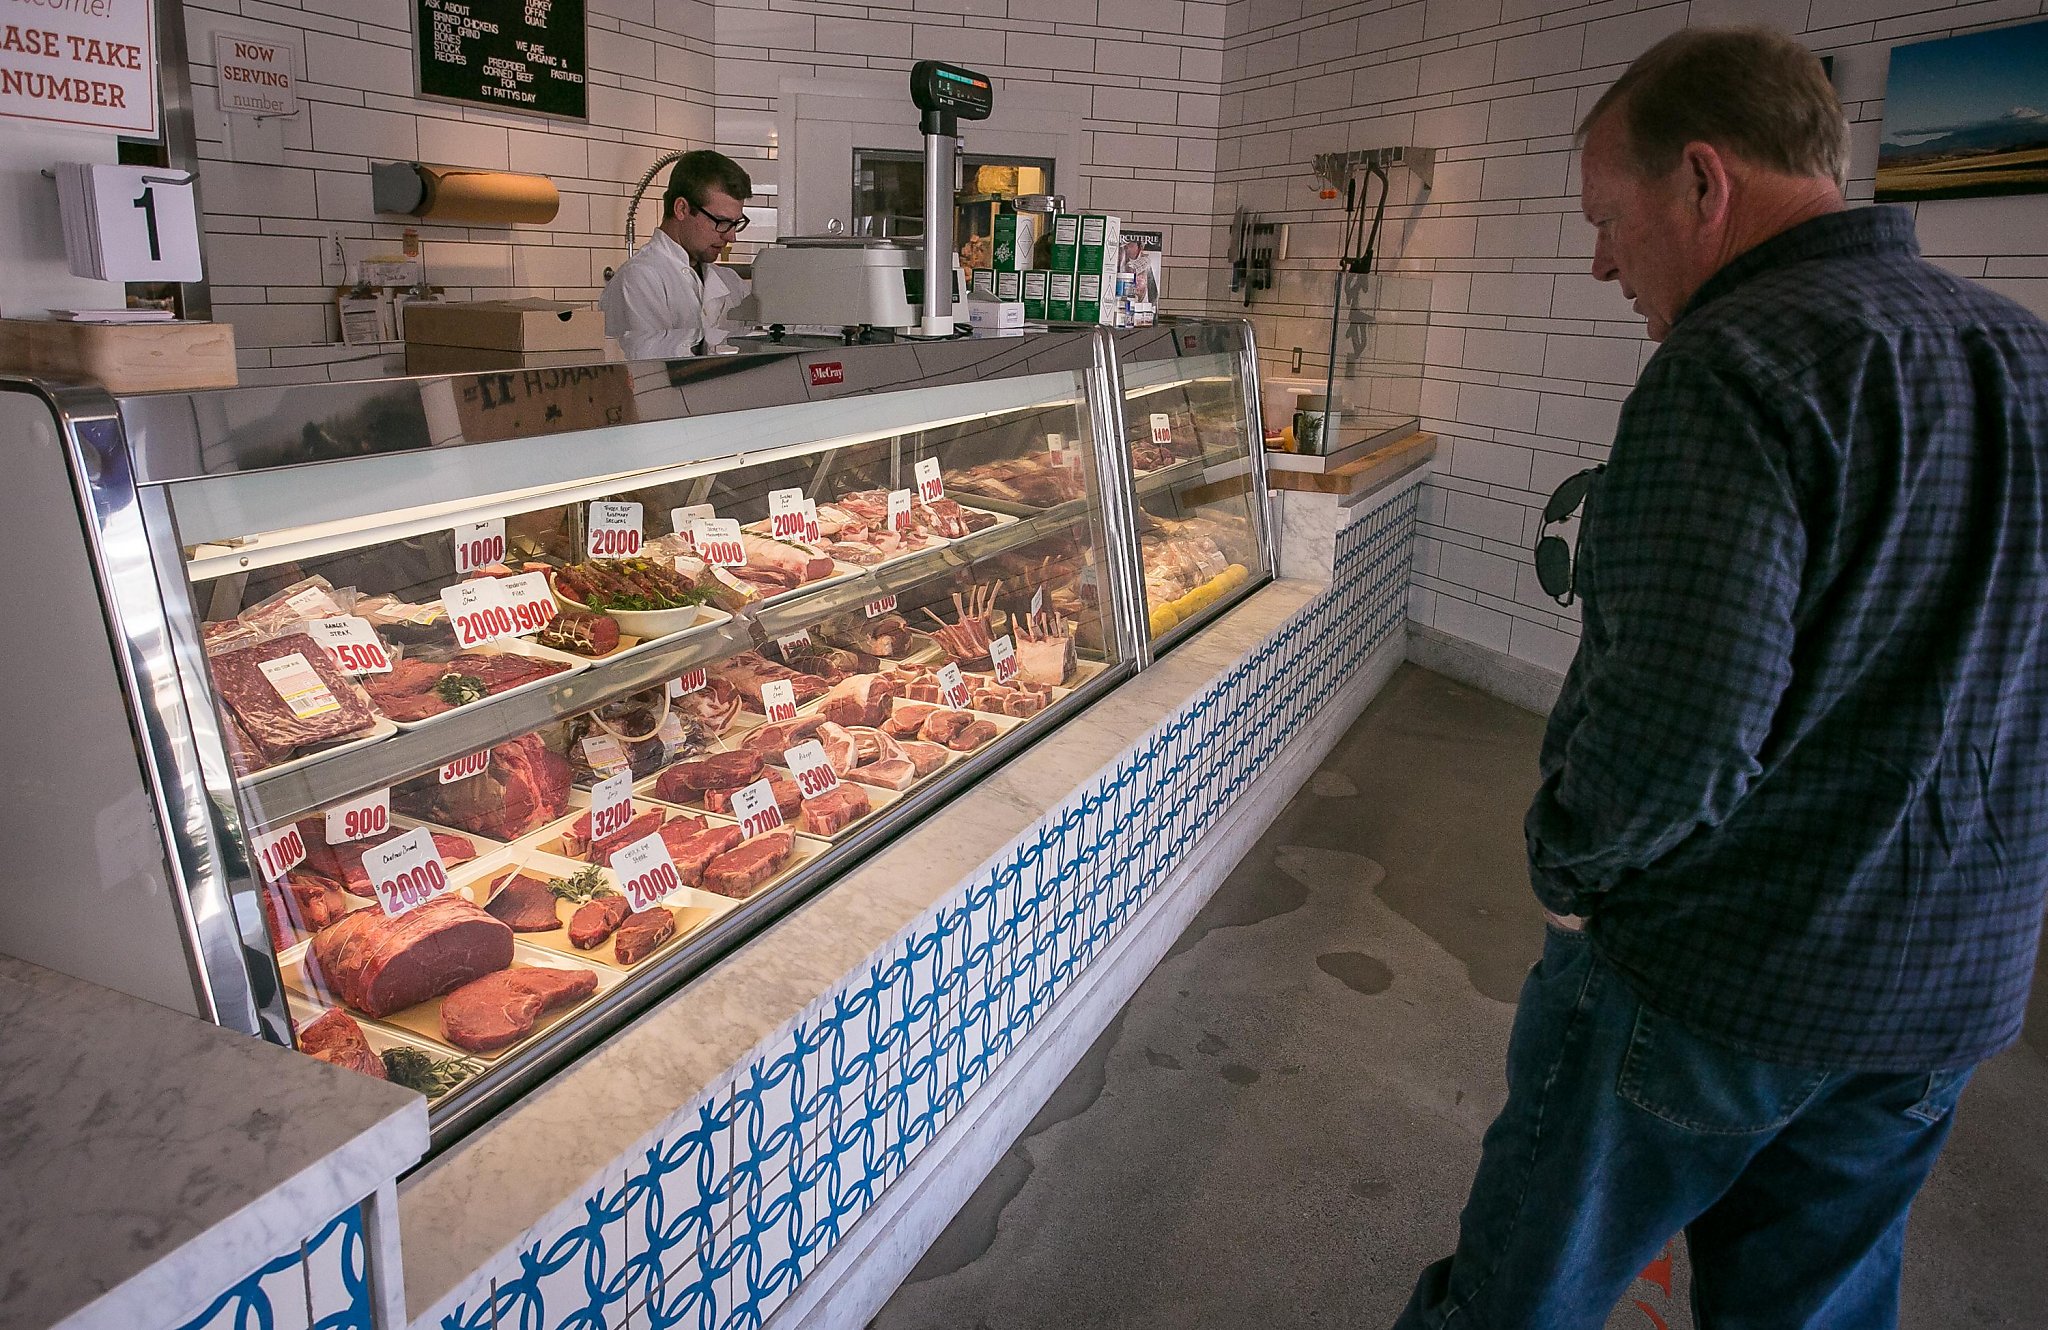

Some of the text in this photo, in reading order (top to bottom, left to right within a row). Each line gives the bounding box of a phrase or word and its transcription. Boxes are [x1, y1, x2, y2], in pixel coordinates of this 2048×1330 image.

[425, 0, 470, 16] ASK ABOUT
[525, 6, 547, 19] OFFAL
[434, 11, 499, 34] BRINED CHICKENS
[434, 21, 480, 40] DOG GRIND
[525, 15, 547, 28] QUAIL
[0, 25, 142, 71] ASE TAKE
[434, 32, 461, 45] BONES
[434, 41, 461, 54] STOCK
[516, 41, 544, 55] WE ARE
[235, 43, 274, 62] NOW
[435, 52, 467, 66] RECIPES
[527, 53, 567, 68] ORGANIC &
[482, 66, 534, 83] CORNED BEEF
[488, 57, 526, 72] PREORDER
[224, 66, 289, 88] SERVING
[501, 78, 516, 89] FOR
[550, 70, 583, 84] PASTURED
[1, 68, 126, 109] NUMBER
[482, 86, 536, 103] ST PATTYS DAY
[233, 93, 284, 112] number
[133, 187, 161, 261] 1
[812, 366, 842, 381] McCray
[920, 477, 943, 501] 1200
[774, 511, 805, 536] 2000
[460, 535, 503, 570] 1000
[592, 529, 639, 554] 2000
[700, 541, 743, 564] 2000
[457, 605, 511, 644] 2000
[328, 643, 387, 670] 500
[798, 763, 837, 795] 3300
[345, 804, 386, 838] 900
[595, 798, 631, 837] 3200
[743, 805, 782, 840] 2700
[262, 830, 303, 877] 1000
[381, 860, 446, 913] 2000
[627, 862, 678, 908] 2000
